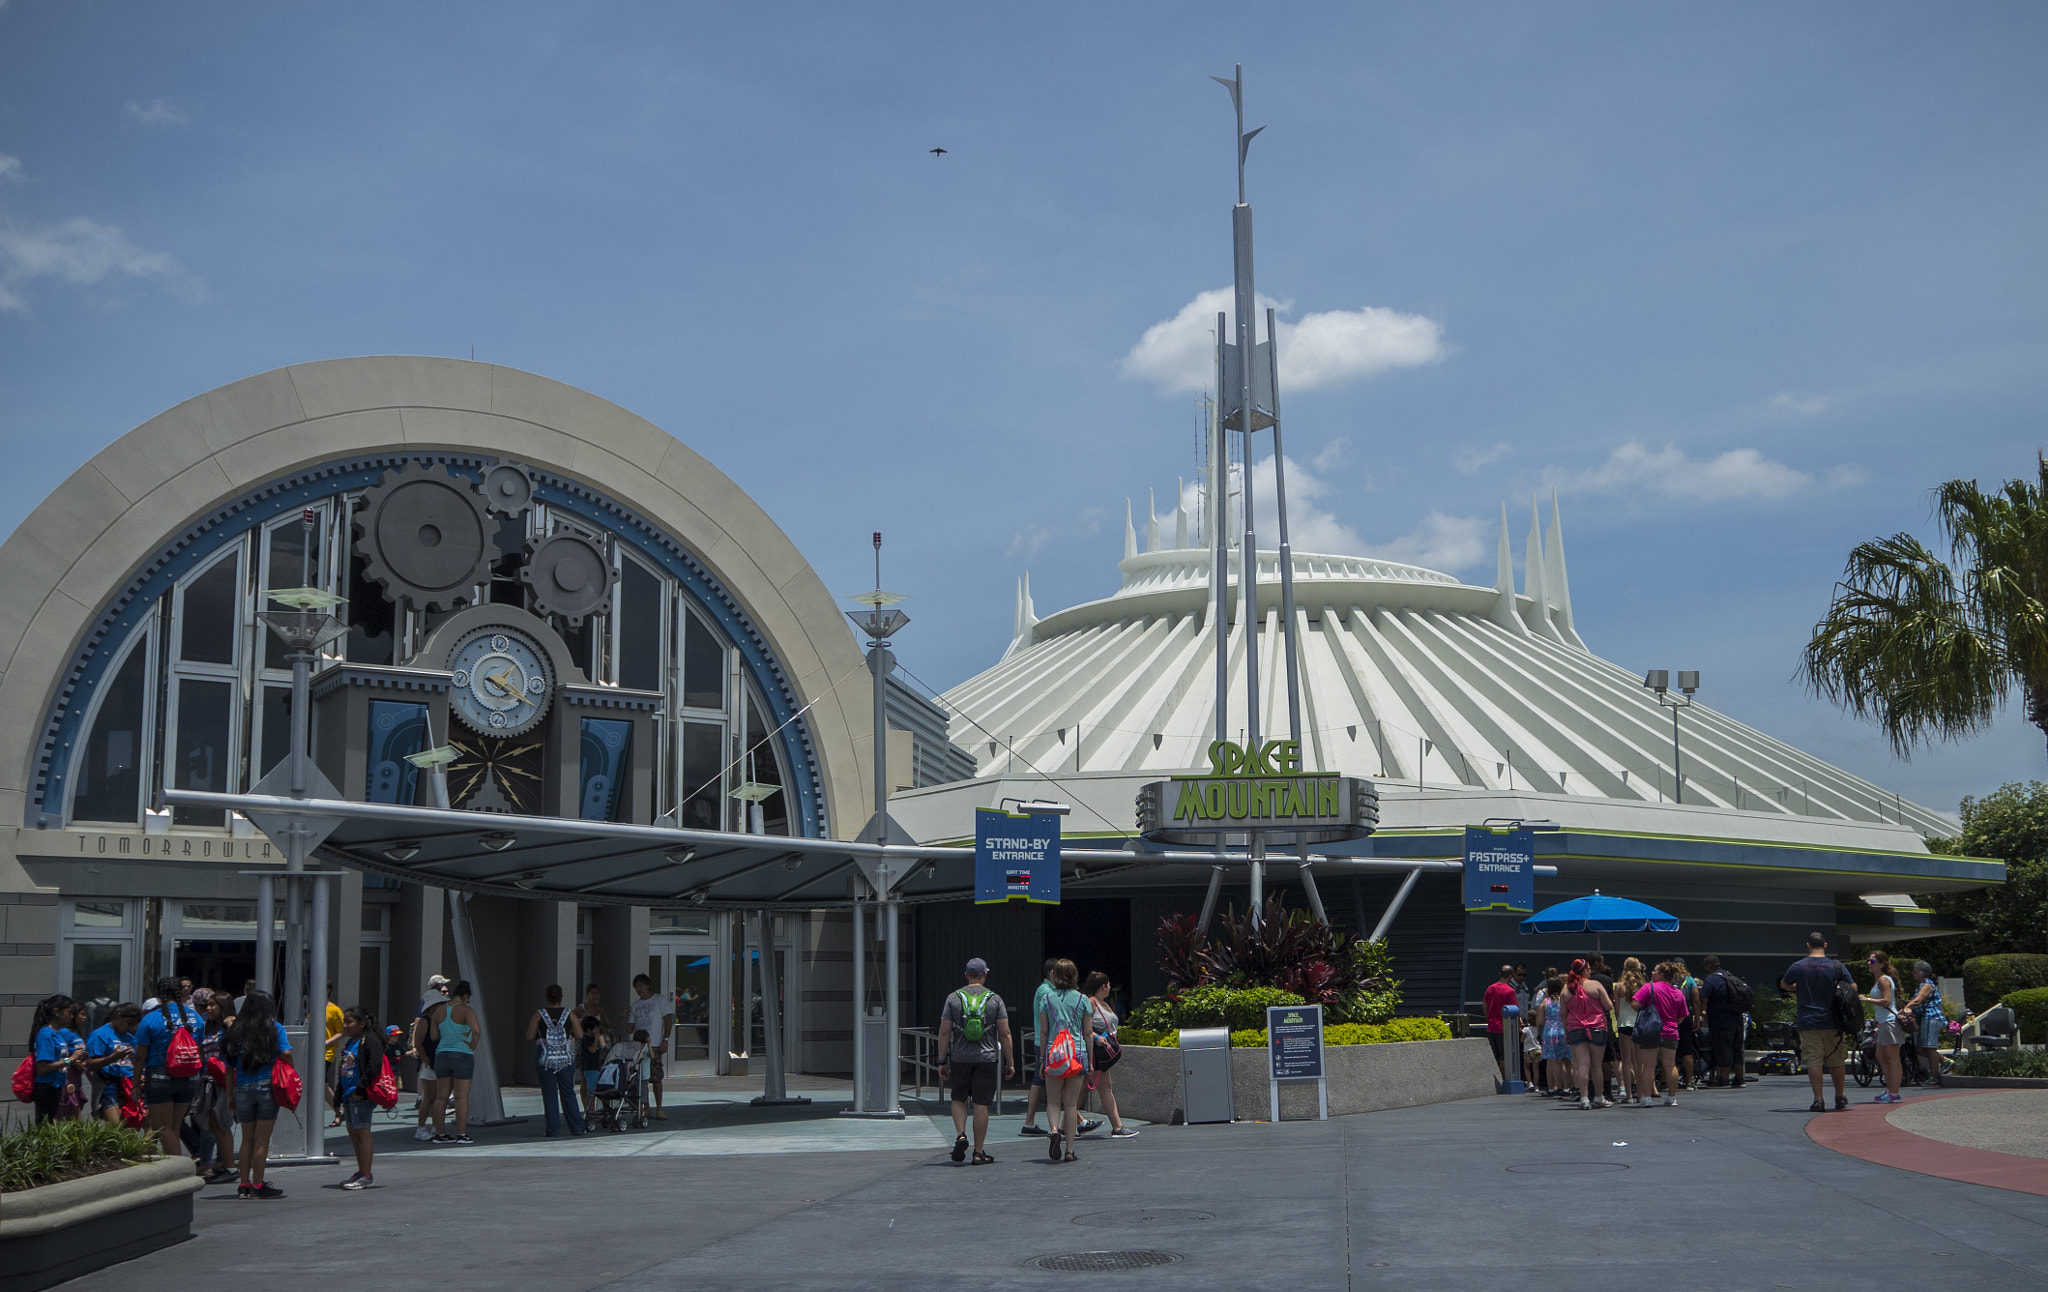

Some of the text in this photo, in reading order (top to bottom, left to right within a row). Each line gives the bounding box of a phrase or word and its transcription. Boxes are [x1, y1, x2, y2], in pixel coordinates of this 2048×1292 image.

[495, 639, 505, 649] 12
[456, 673, 464, 683] 9
[533, 680, 540, 690] 3
[1208, 738, 1299, 775] SPACE
[1174, 778, 1339, 823] MOUNTAIN
[78, 836, 272, 858] TOMORROWLA
[985, 838, 1050, 850] STAND-BY
[992, 851, 1044, 860] ENTRANCE
[1469, 852, 1530, 863] FASTPASS+
[1479, 864, 1520, 872] ENTRANCE
